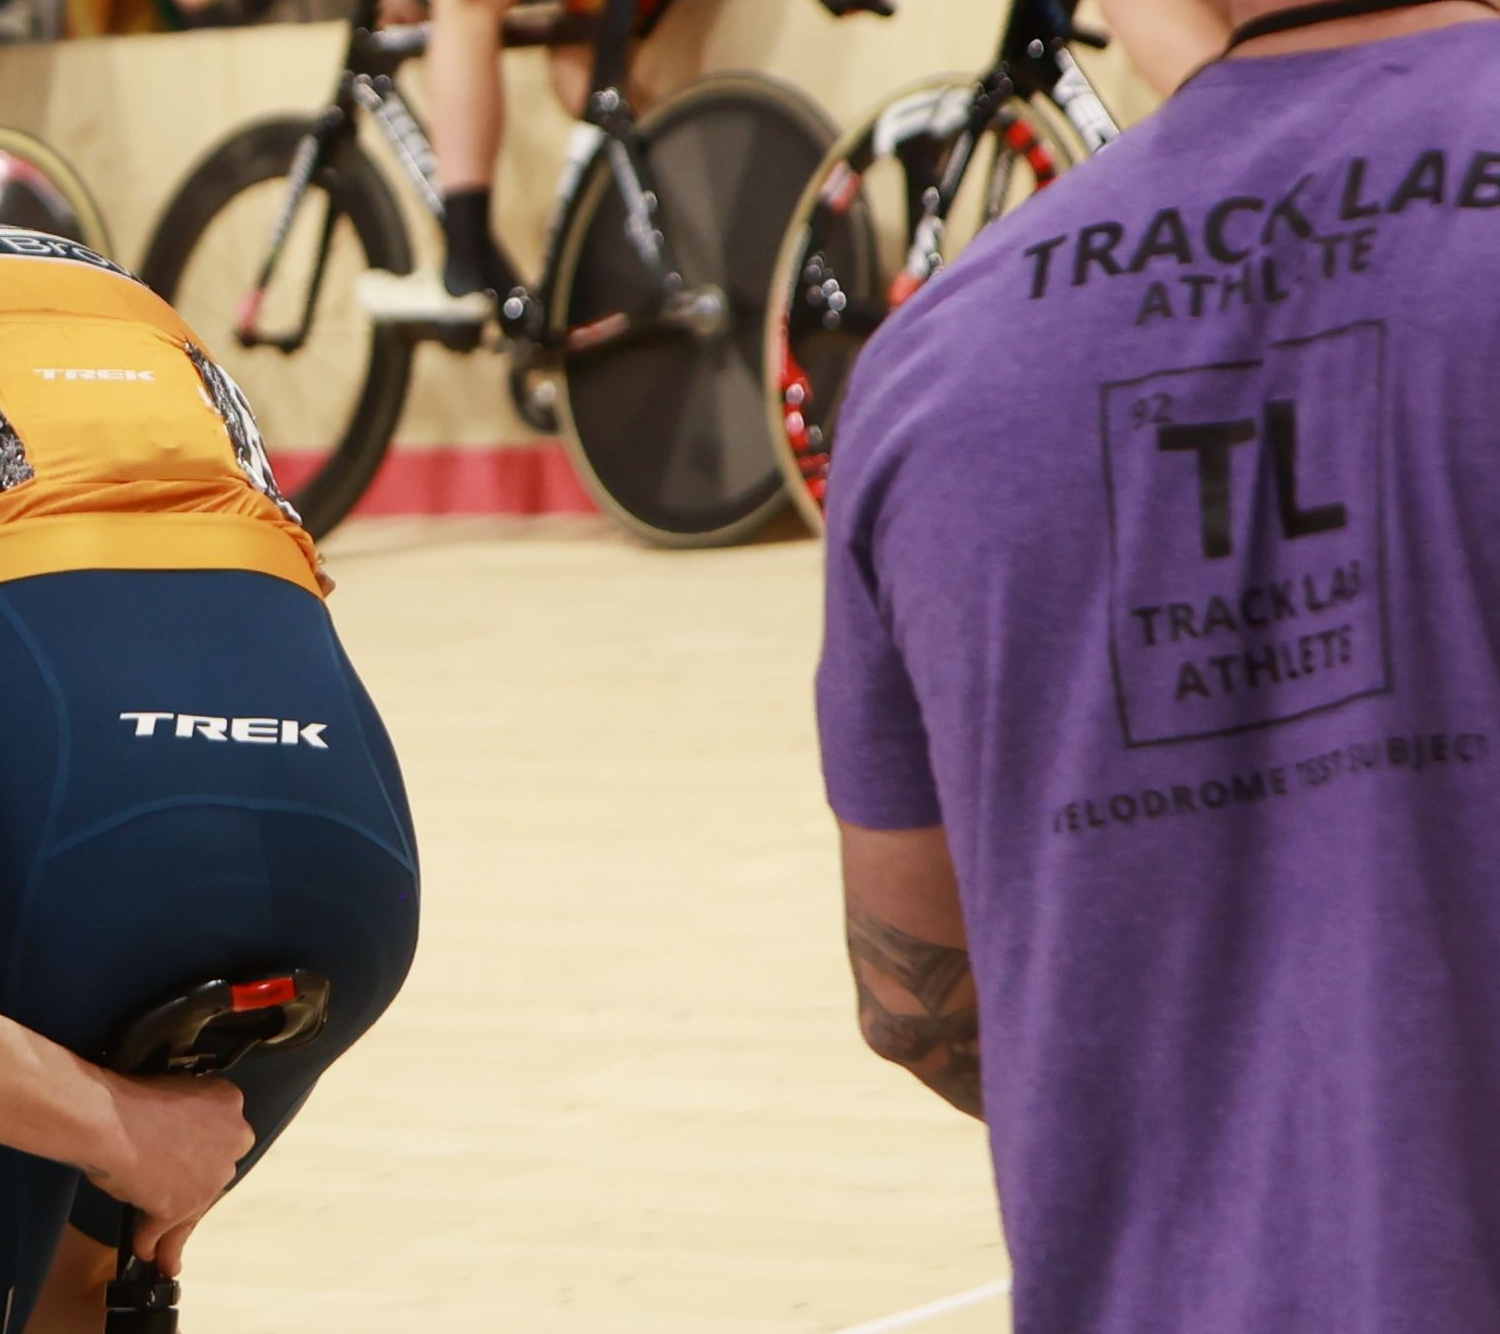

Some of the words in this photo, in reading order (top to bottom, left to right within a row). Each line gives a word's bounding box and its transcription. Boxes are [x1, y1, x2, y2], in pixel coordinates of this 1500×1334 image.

[1024, 173, 1315, 300] TRACK
[1340, 148, 1500, 220] LAB
[1134, 227, 1378, 327] ATHLTE
[34, 367, 157, 382] TREK
[1132, 392, 1176, 430] 92
[1156, 398, 1347, 560] TL
[1132, 580, 1295, 647] TRACK
[119, 712, 329, 749] TREK
